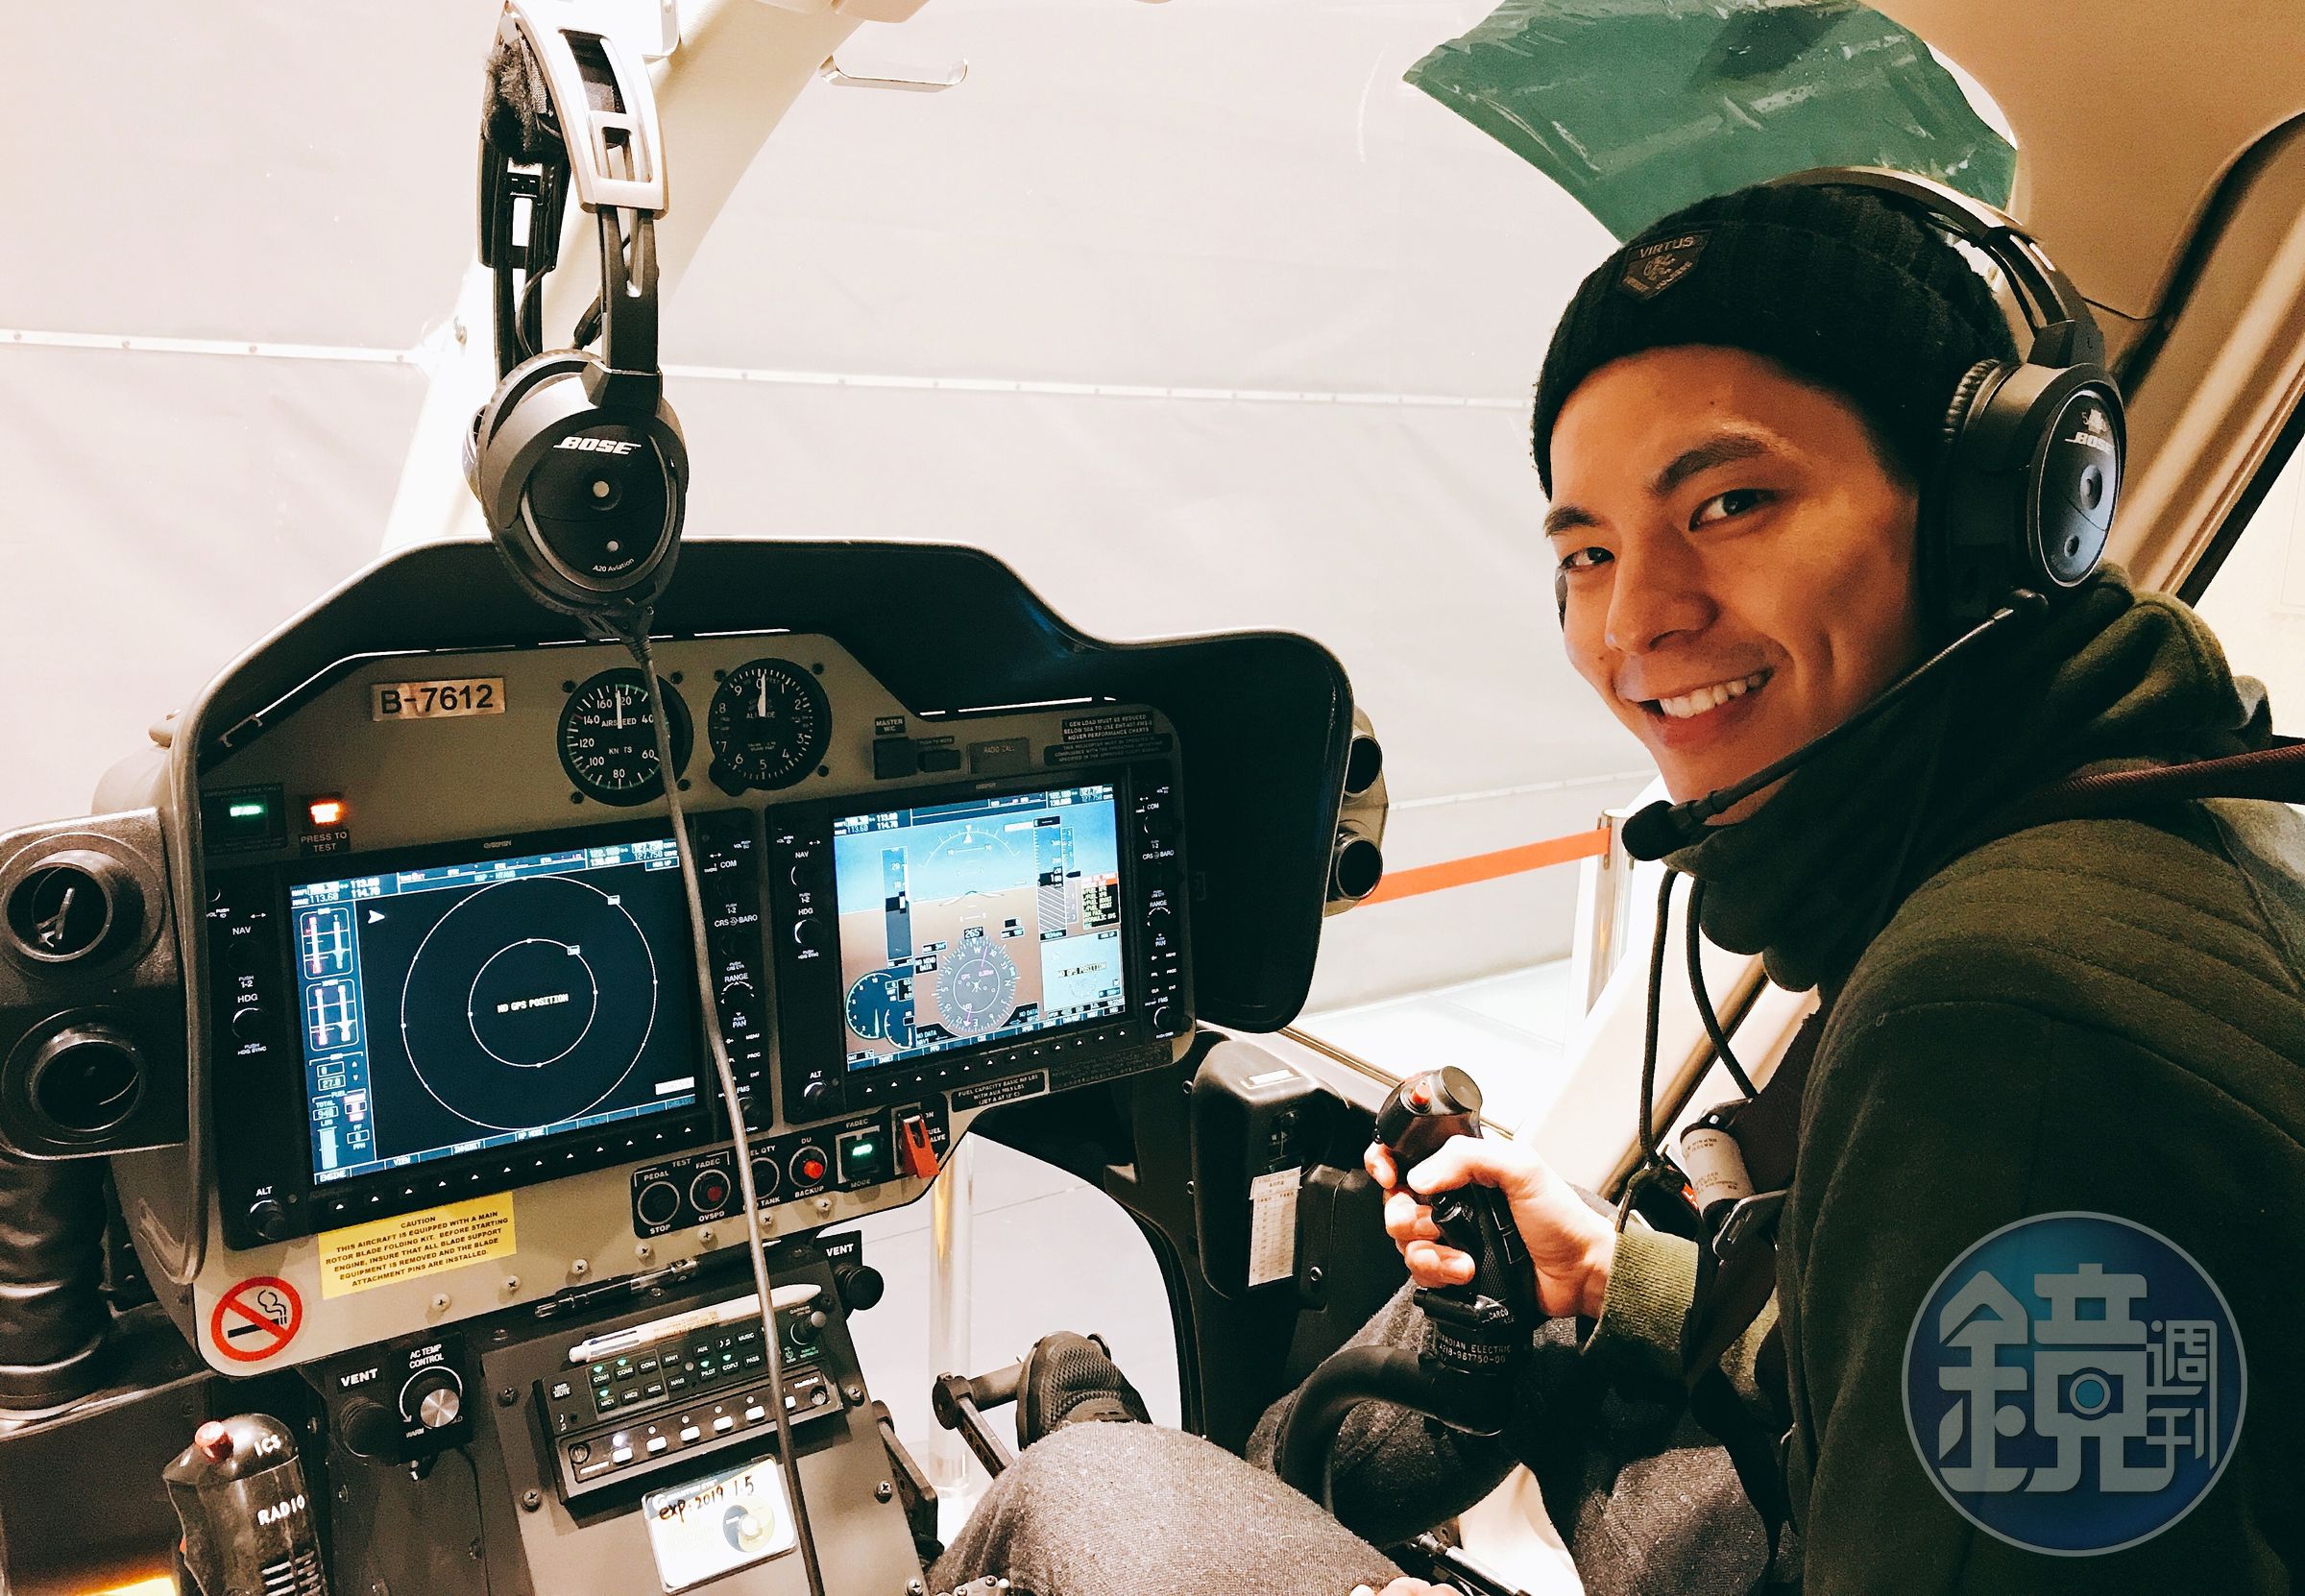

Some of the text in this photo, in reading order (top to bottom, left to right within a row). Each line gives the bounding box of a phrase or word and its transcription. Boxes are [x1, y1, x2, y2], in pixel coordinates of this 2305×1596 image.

[1639, 236, 1694, 258] VIRTUS
[553, 436, 642, 455] BOSE
[2065, 431, 2114, 455] BOSE
[607, 558, 635, 572] Aviation
[734, 685, 742, 696] 9
[381, 684, 494, 714] B-7612
[596, 699, 613, 709] 160
[794, 699, 801, 710] 2
[718, 703, 726, 713] 8
[583, 715, 600, 725] 140
[601, 718, 637, 727] AIRSEED
[642, 714, 654, 723] 40
[579, 738, 594, 748] 120
[796, 733, 804, 744] 3
[609, 746, 633, 755] KNTS
[720, 740, 727, 752] 7
[642, 749, 654, 759] 60
[735, 753, 743, 764] 6
[782, 749, 789, 759] 4
[589, 757, 605, 765] 100
[760, 759, 766, 770] 5
[613, 769, 625, 778] 80
[301, 834, 332, 843] PRESS
[313, 843, 337, 852] TEST
[739, 914, 758, 923] BARO
[232, 926, 252, 935] NAV
[724, 973, 749, 982] RANGE
[237, 994, 258, 1004] HDG
[497, 993, 569, 1013] NO GPS POSITION
[732, 1020, 747, 1028] PAN
[975, 1083, 1002, 1093] CAPACITY
[845, 1118, 868, 1128] FADEC
[761, 1145, 776, 1154] QTY
[672, 1158, 692, 1168] TEST
[695, 1158, 721, 1169] FADEC
[643, 1171, 669, 1181] PEDAL
[851, 1179, 870, 1188] MODE
[255, 1186, 273, 1197] ALT
[794, 1186, 824, 1197] BACKUP
[761, 1196, 781, 1206] TANK
[698, 1211, 725, 1222] OVSPD
[400, 1217, 436, 1228] CAUTION
[336, 1244, 355, 1253] THIS
[357, 1234, 397, 1247] AIRCRAFT
[409, 1222, 448, 1236] EQUIPPED
[449, 1218, 470, 1226] WITH
[478, 1211, 498, 1221] MAIN
[649, 1224, 670, 1235] STOP
[326, 1253, 353, 1265] ROTOR
[355, 1247, 382, 1258] BLADE
[384, 1239, 419, 1250] FOLDING
[439, 1226, 470, 1238] BEFORE
[472, 1218, 508, 1230] STARTING
[370, 1252, 400, 1263] INSURE
[401, 1246, 422, 1255] THAT
[440, 1237, 466, 1246] BLADE
[468, 1228, 502, 1240] SUPPORT
[826, 1244, 854, 1257] VENT
[340, 1265, 387, 1280] EQUIPMENT
[400, 1252, 437, 1266] REMOVED
[474, 1238, 498, 1247] BLADE
[352, 1270, 405, 1286] ATTACHMENT
[408, 1264, 426, 1272] PINS
[1489, 1308, 1509, 1320] CARGO
[738, 1332, 755, 1342] MUSIC
[1439, 1332, 1511, 1354] ARDIAN ELECTRIC
[409, 1343, 442, 1359] AC TEMP
[409, 1353, 444, 1368] CONTROL
[746, 1355, 761, 1364] PASS
[617, 1367, 634, 1376] COM2
[722, 1362, 739, 1370] COPLT
[340, 1367, 378, 1387] VENT
[701, 1367, 716, 1377] PILOT
[594, 1373, 610, 1383] COM1
[553, 1389, 570, 1398] MUTE
[405, 1428, 425, 1439] WARM
[254, 1434, 281, 1457] ICS
[694, 1485, 724, 1509] 2019
[257, 1494, 305, 1526] RADIO
